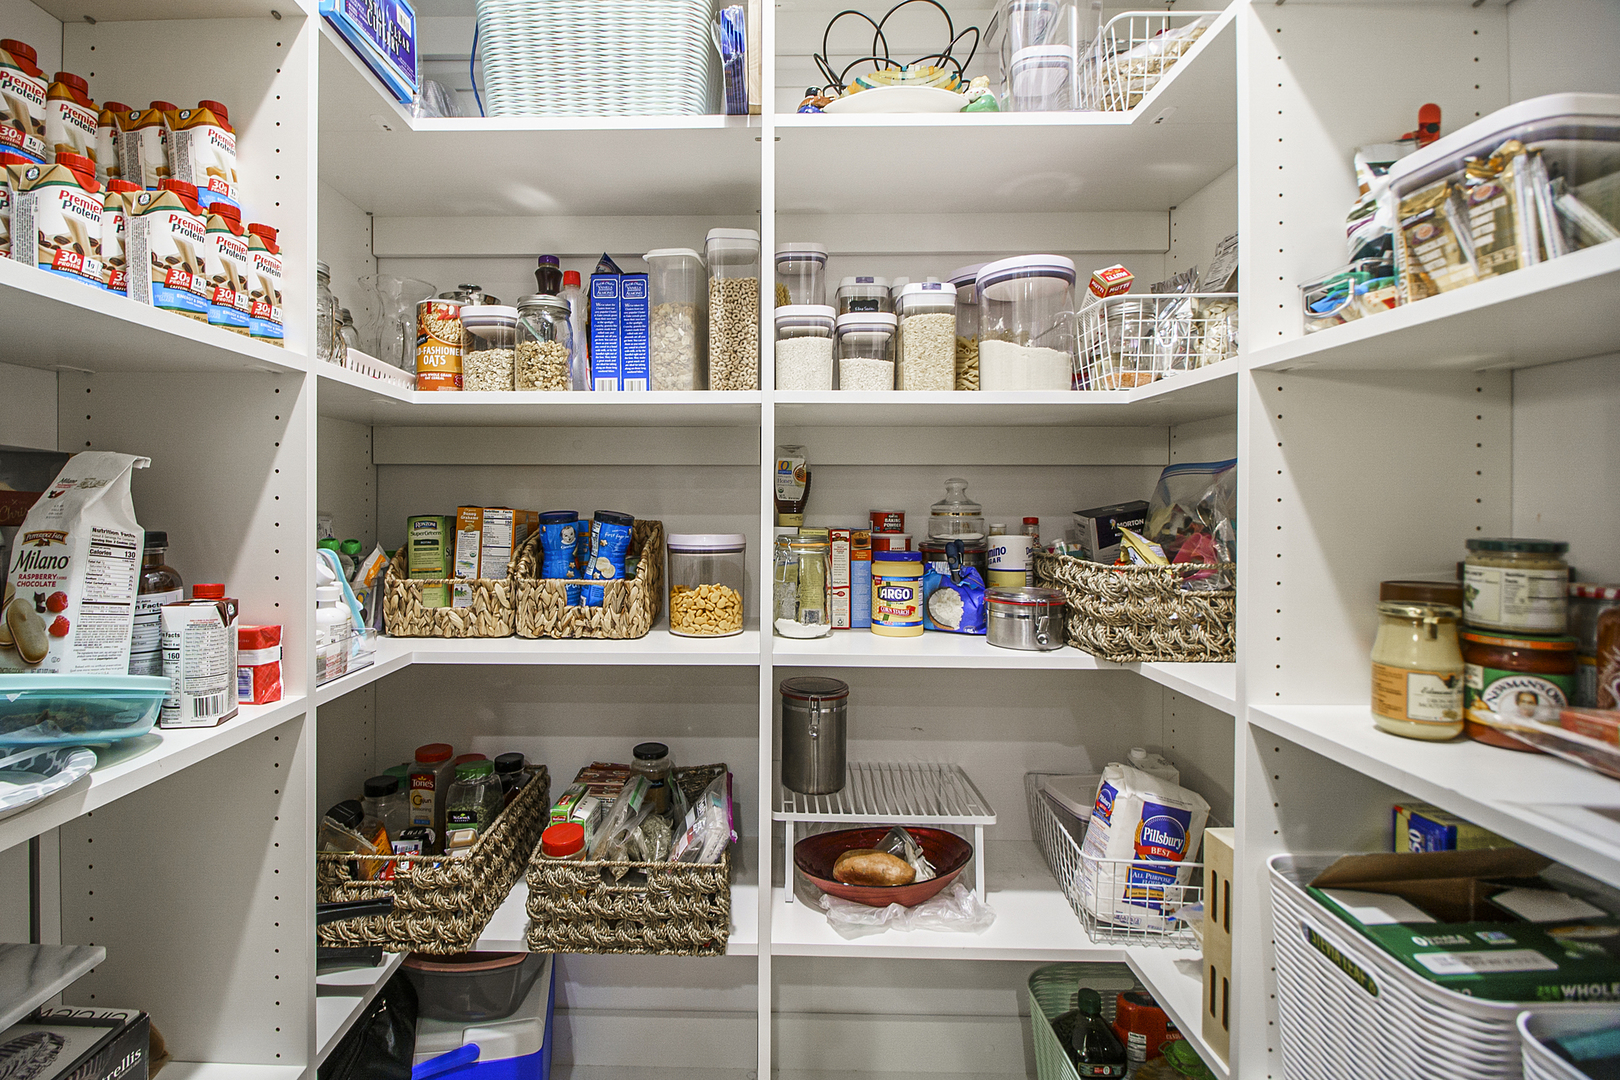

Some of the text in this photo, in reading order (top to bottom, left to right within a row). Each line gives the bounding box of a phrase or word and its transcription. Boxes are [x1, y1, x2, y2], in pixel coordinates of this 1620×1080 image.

[367, 7, 399, 56] CUTLERY
[389, 19, 410, 54] CLEAR
[0, 70, 46, 99] Premier
[1, 79, 43, 106] Protein
[60, 103, 97, 130] Premier
[62, 112, 96, 135] Protein
[0, 126, 22, 140] 30g
[210, 136, 236, 157] Protein
[58, 189, 103, 216] Premier
[61, 199, 100, 223] Protein
[168, 213, 206, 237] Premier
[171, 223, 205, 243] Protein
[215, 235, 248, 256] Premier
[218, 244, 247, 262] Protein
[58, 250, 82, 266] 30g
[87, 260, 95, 270] 1g
[170, 270, 190, 284] 30g
[256, 261, 281, 278] Protein
[1105, 271, 1129, 281] MUTTI
[1091, 279, 1104, 294] MUTTI
[1109, 280, 1130, 293] MUTTI
[416, 345, 463, 357] -FASHIONE
[423, 354, 447, 367] OATS
[777, 477, 793, 485] Honey
[1116, 519, 1144, 529] MORTON
[26, 532, 52, 541] PEPPERIDGE
[124, 550, 136, 558] 130
[988, 545, 1007, 557] mino
[11, 549, 70, 574] Milano
[16, 580, 57, 588] CHOCOLATE
[18, 573, 57, 581] RASPBERRY
[880, 588, 910, 600] ARGO
[142, 602, 164, 610] Facts
[1486, 680, 1546, 705] NEWMAN'S
[411, 778, 434, 788] Tone's
[1143, 826, 1183, 850] Pillsbury
[1150, 846, 1171, 858] BEST
[1132, 871, 1172, 883] ALL PURPOSE
[1561, 983, 1620, 998] WHOLE
[102, 1048, 142, 1080] rellis
